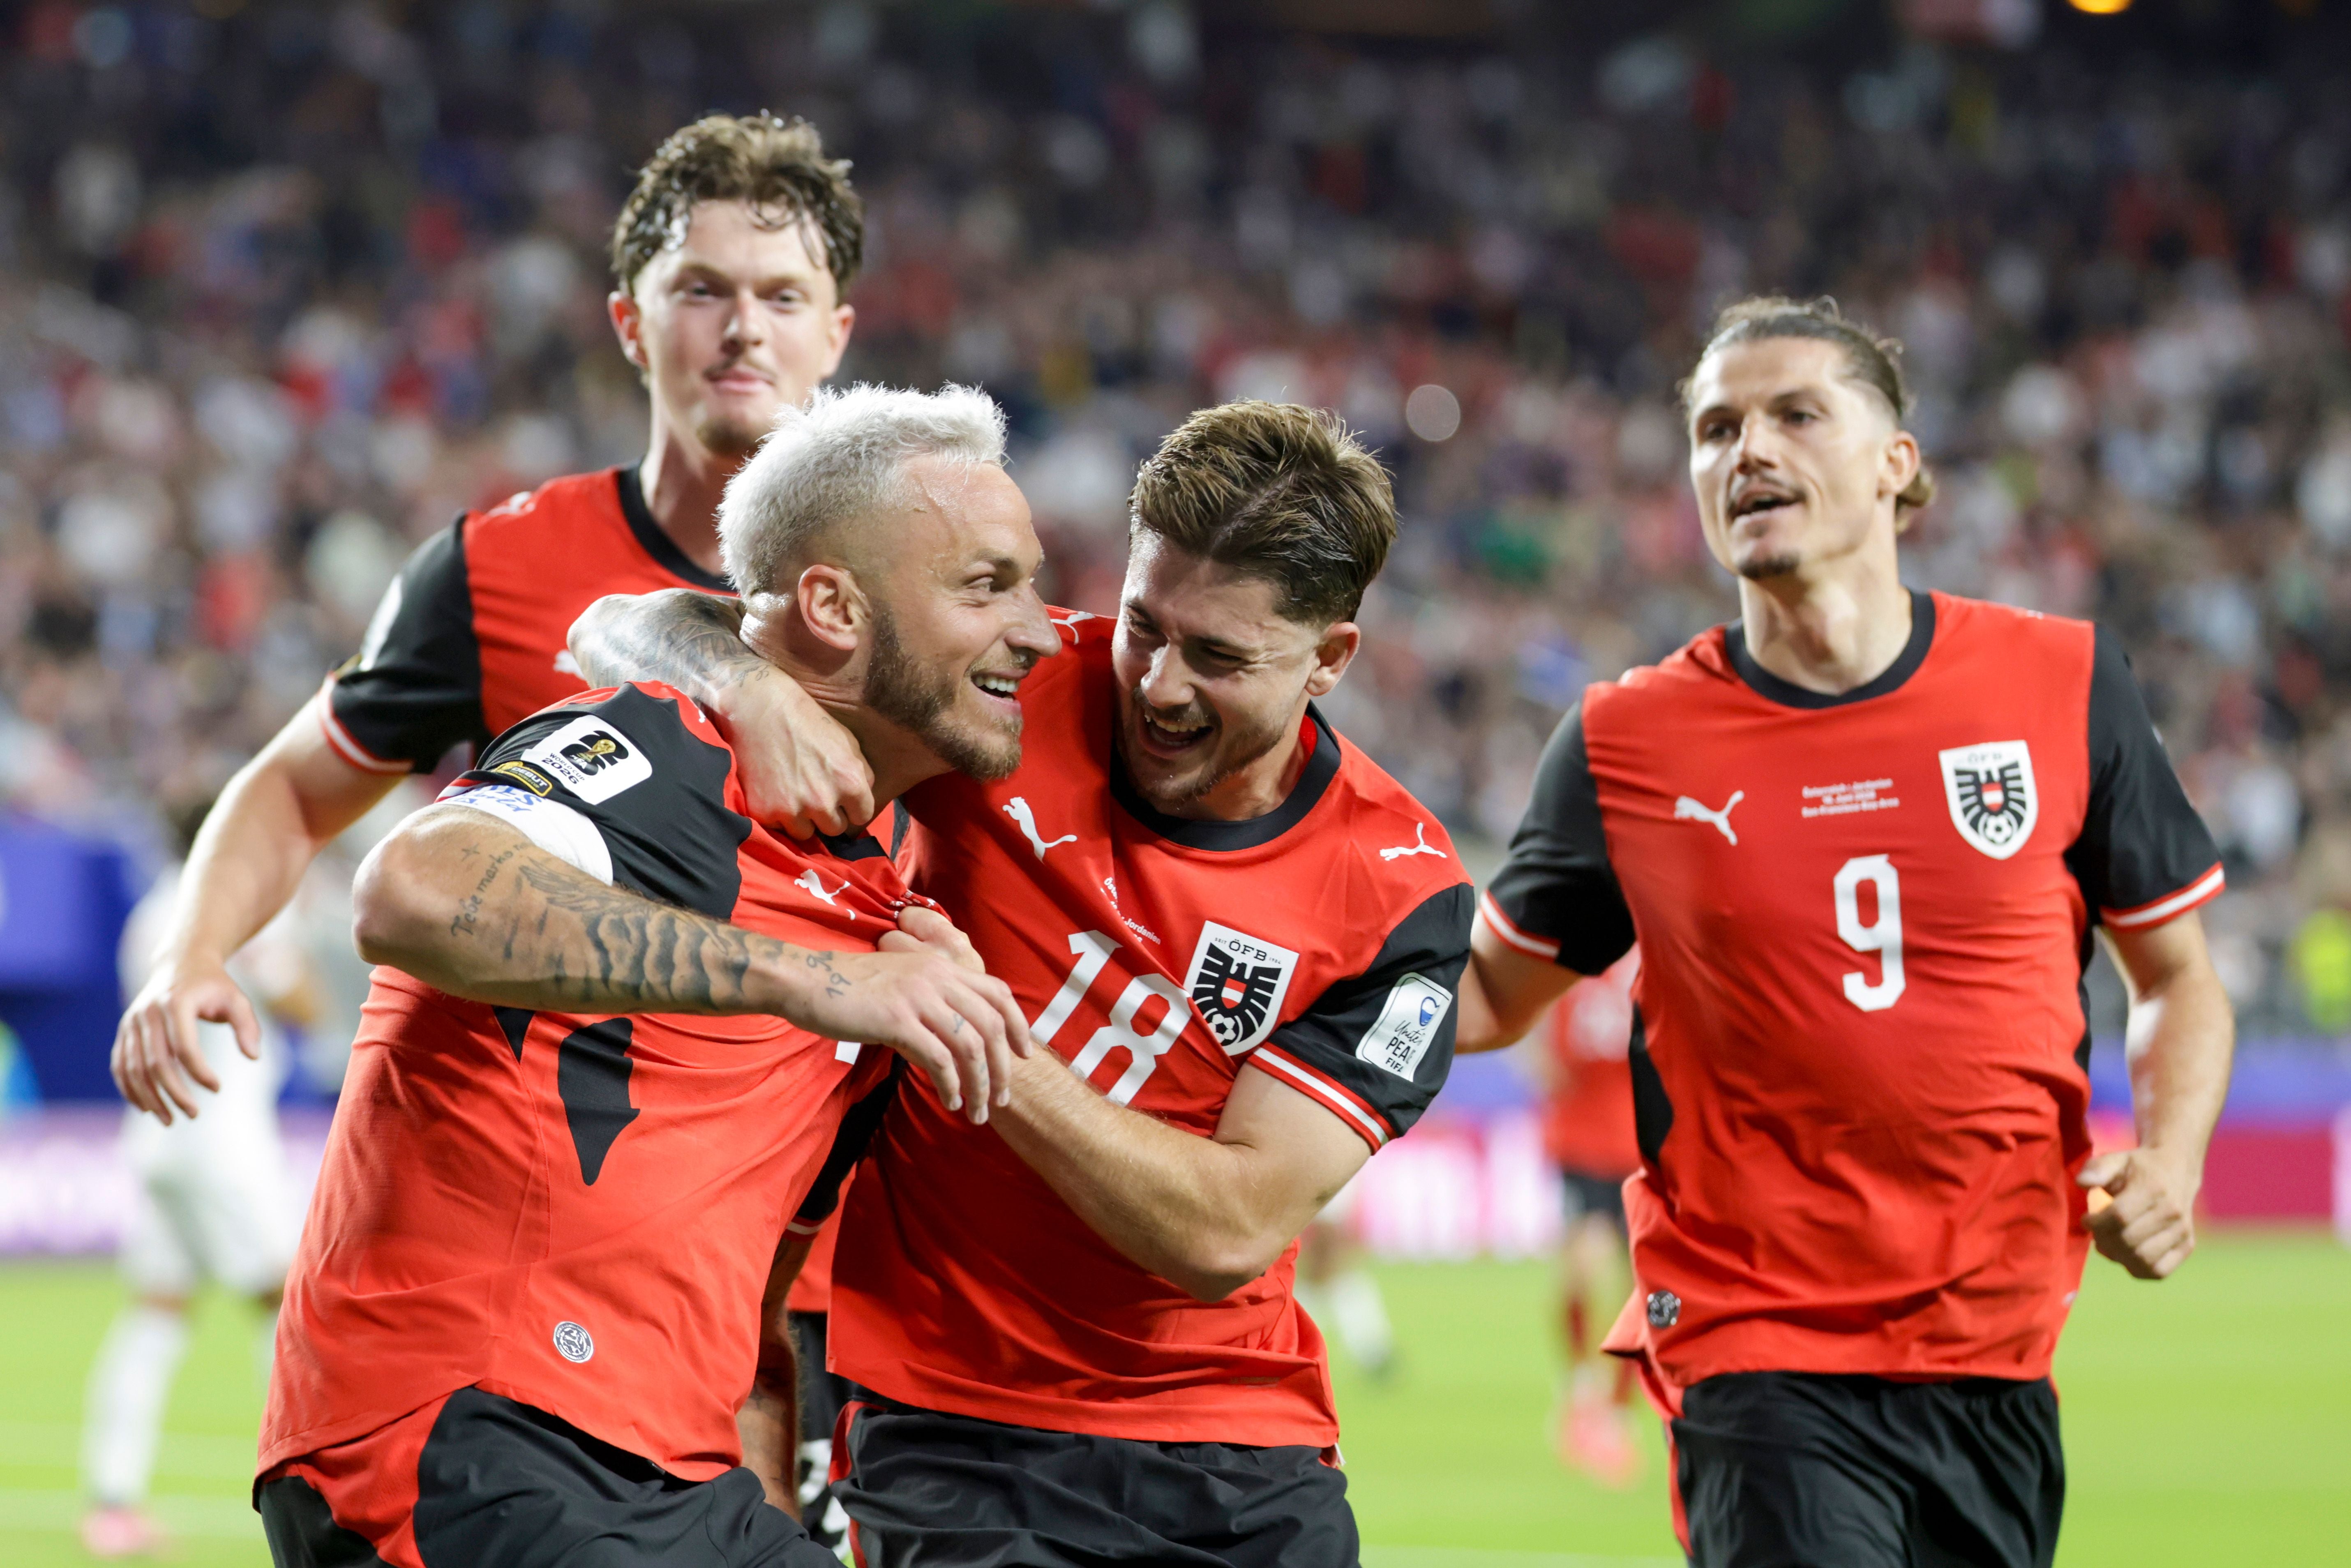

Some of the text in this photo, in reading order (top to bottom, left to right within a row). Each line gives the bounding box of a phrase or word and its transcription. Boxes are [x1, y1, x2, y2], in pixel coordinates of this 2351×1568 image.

[511, 767, 548, 786] DEBUT
[541, 757, 579, 784] 2026
[549, 753, 585, 781] WORLD CUP
[1124, 918, 1161, 945] Jordanien
[1833, 853, 1906, 1012] 9
[1229, 938, 1267, 962] ÖFB
[1029, 929, 1193, 1108] 18
